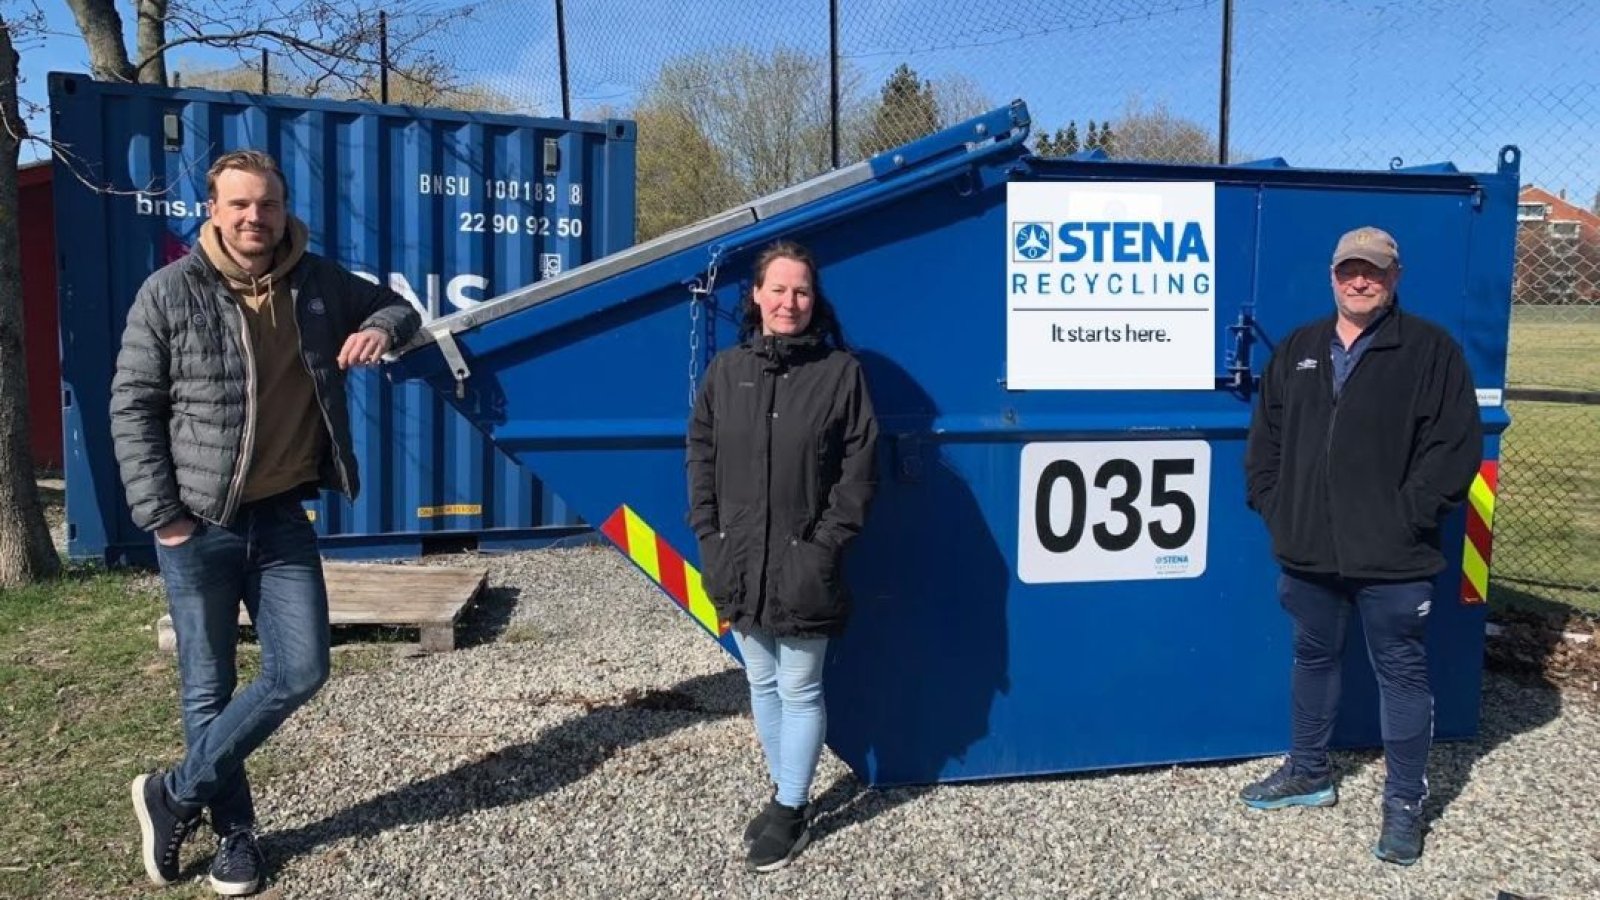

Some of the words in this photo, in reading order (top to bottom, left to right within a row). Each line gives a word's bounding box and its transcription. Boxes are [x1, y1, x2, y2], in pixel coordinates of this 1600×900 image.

[420, 174, 469, 196] BNSU
[486, 179, 555, 203] 100183
[571, 185, 580, 204] 8
[136, 193, 211, 217] bns.n
[460, 212, 486, 232] 22
[493, 214, 518, 234] 90
[526, 216, 549, 236] 92
[557, 218, 582, 237] 50
[1058, 222, 1210, 263] STENA
[1012, 273, 1210, 295] RECYCLING
[350, 271, 489, 328] NS
[1052, 324, 1065, 342] It
[1068, 326, 1121, 342] starts
[1126, 324, 1171, 342] here.
[1035, 459, 1196, 553] 035
